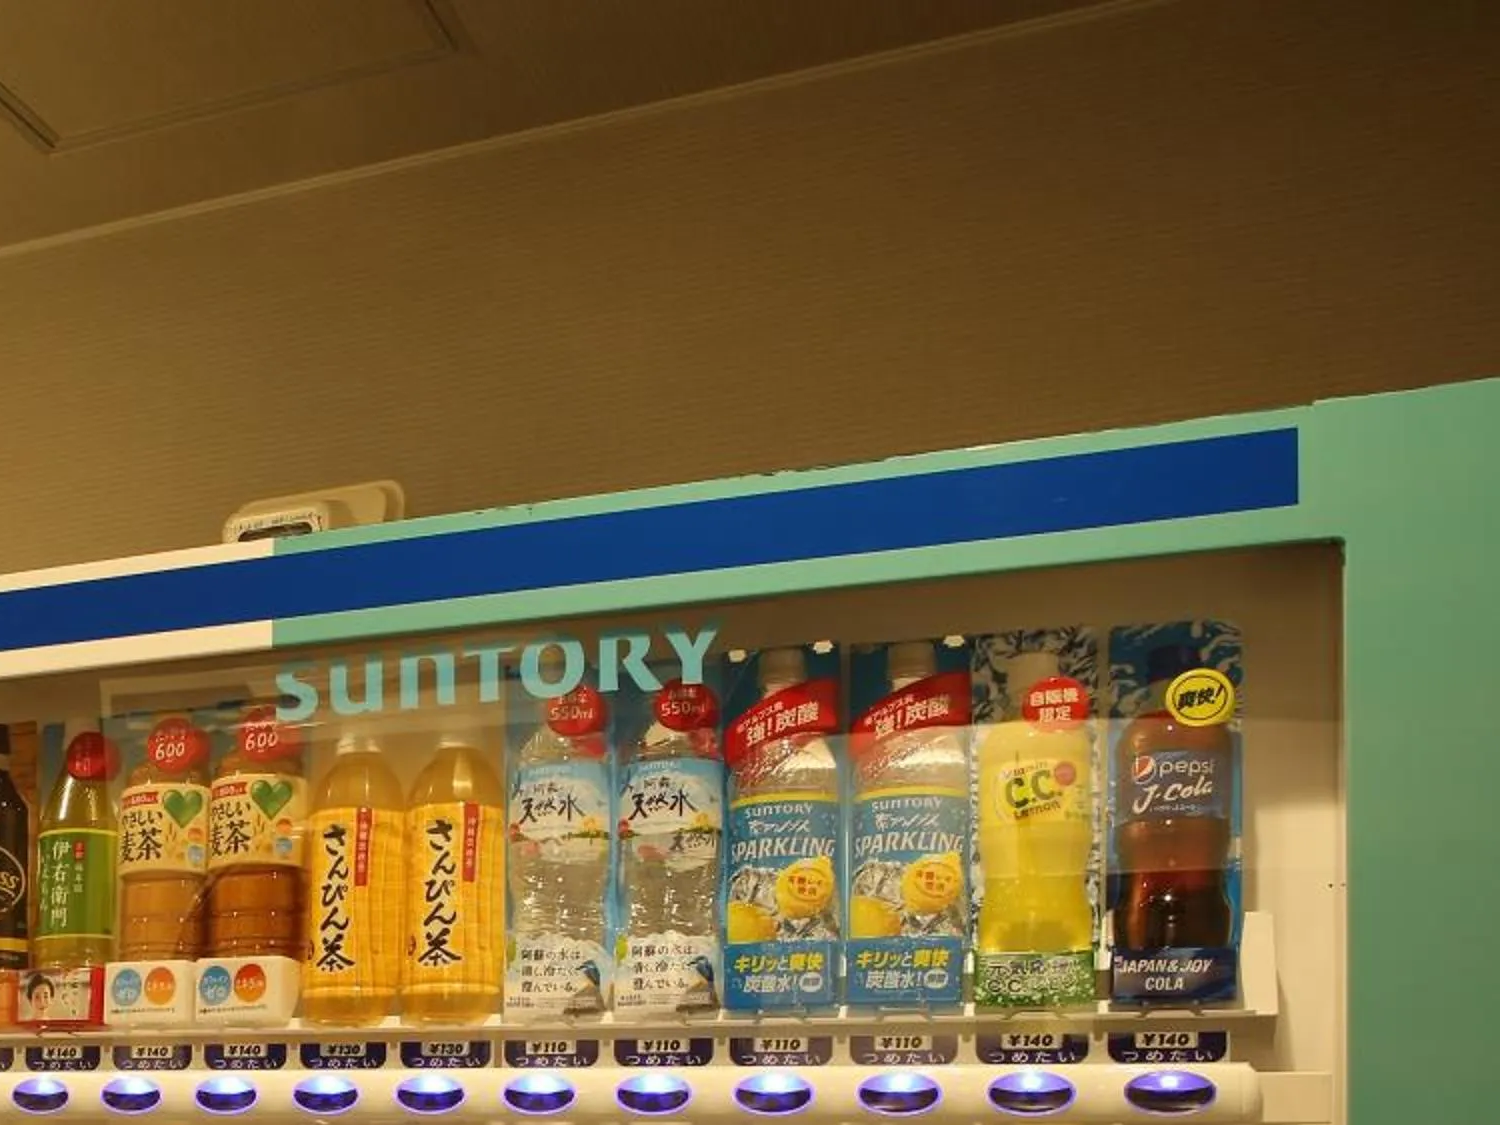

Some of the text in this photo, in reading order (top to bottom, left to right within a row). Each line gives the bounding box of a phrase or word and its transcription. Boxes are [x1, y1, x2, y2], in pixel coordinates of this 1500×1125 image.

[245, 731, 278, 751] 600
[155, 743, 185, 761] 600
[731, 838, 835, 864] SPARKLING
[854, 831, 965, 860] SPARKLING
[316, 824, 356, 971] さんぴん茶
[417, 819, 462, 967] さんぴん茶
[1145, 977, 1185, 991] COLA
[643, 1039, 681, 1051] ¥110
[761, 1038, 801, 1050] ¥110
[881, 1037, 923, 1049] ¥110
[1008, 1034, 1054, 1047] ¥140
[1142, 1033, 1190, 1047] ¥140
[47, 1047, 77, 1058] ¥140
[135, 1046, 169, 1058] ¥140
[228, 1044, 262, 1056] ¥140
[327, 1043, 361, 1055] ¥130
[429, 1042, 463, 1054] ¥130
[531, 1041, 568, 1053] ¥110
[515, 1055, 590, 1067] つめたい
[625, 1053, 701, 1066] つめたい
[742, 1053, 821, 1065] つめたい
[862, 1051, 946, 1064] つめたい
[988, 1050, 1076, 1063] つめたい
[1122, 1049, 1214, 1062] つめたい
[33, 1060, 94, 1071] つめたい
[122, 1059, 185, 1070] つめたい
[213, 1057, 278, 1069] つめたい
[309, 1056, 378, 1069] つめたい
[412, 1056, 481, 1069] つめたい
